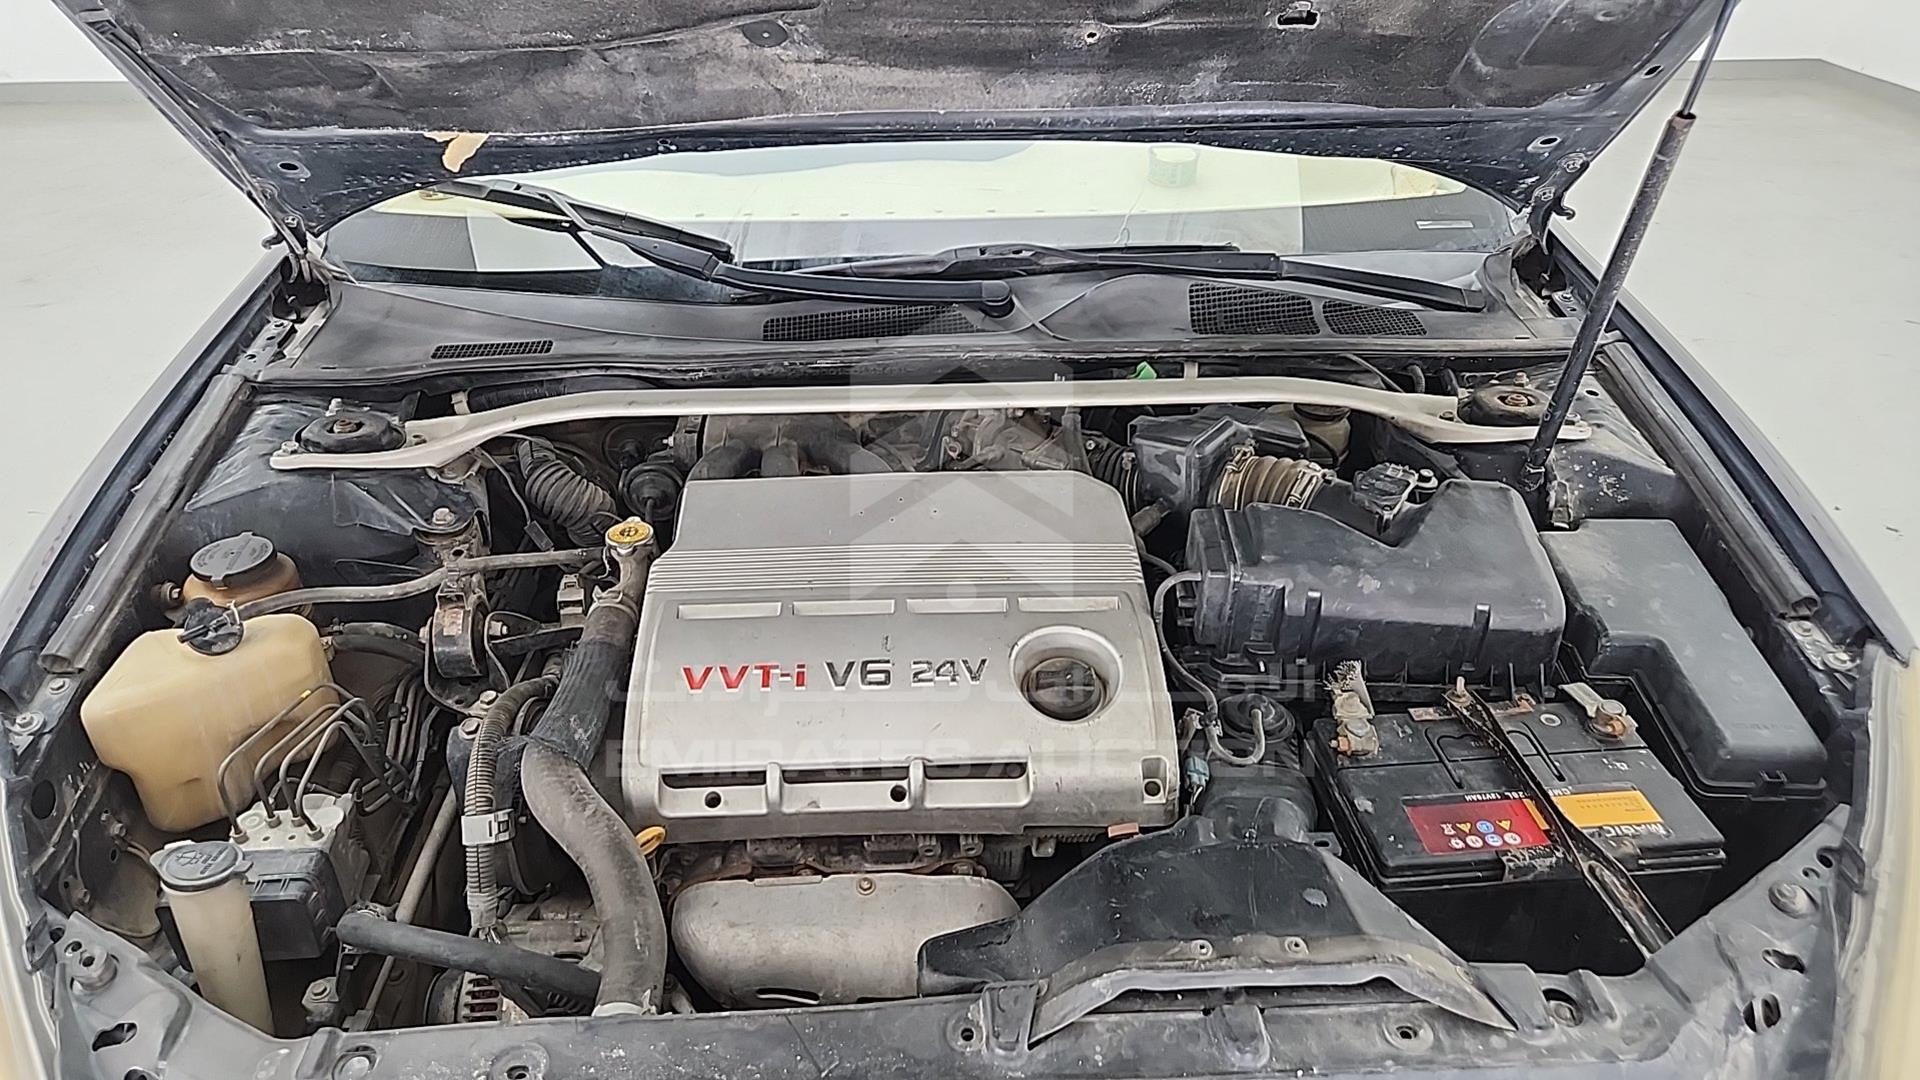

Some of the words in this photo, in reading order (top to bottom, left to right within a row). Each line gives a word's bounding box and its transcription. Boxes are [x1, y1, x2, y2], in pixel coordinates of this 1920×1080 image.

[681, 662, 808, 693] VVT-i
[825, 659, 893, 690] V6
[910, 658, 988, 687] 24V
